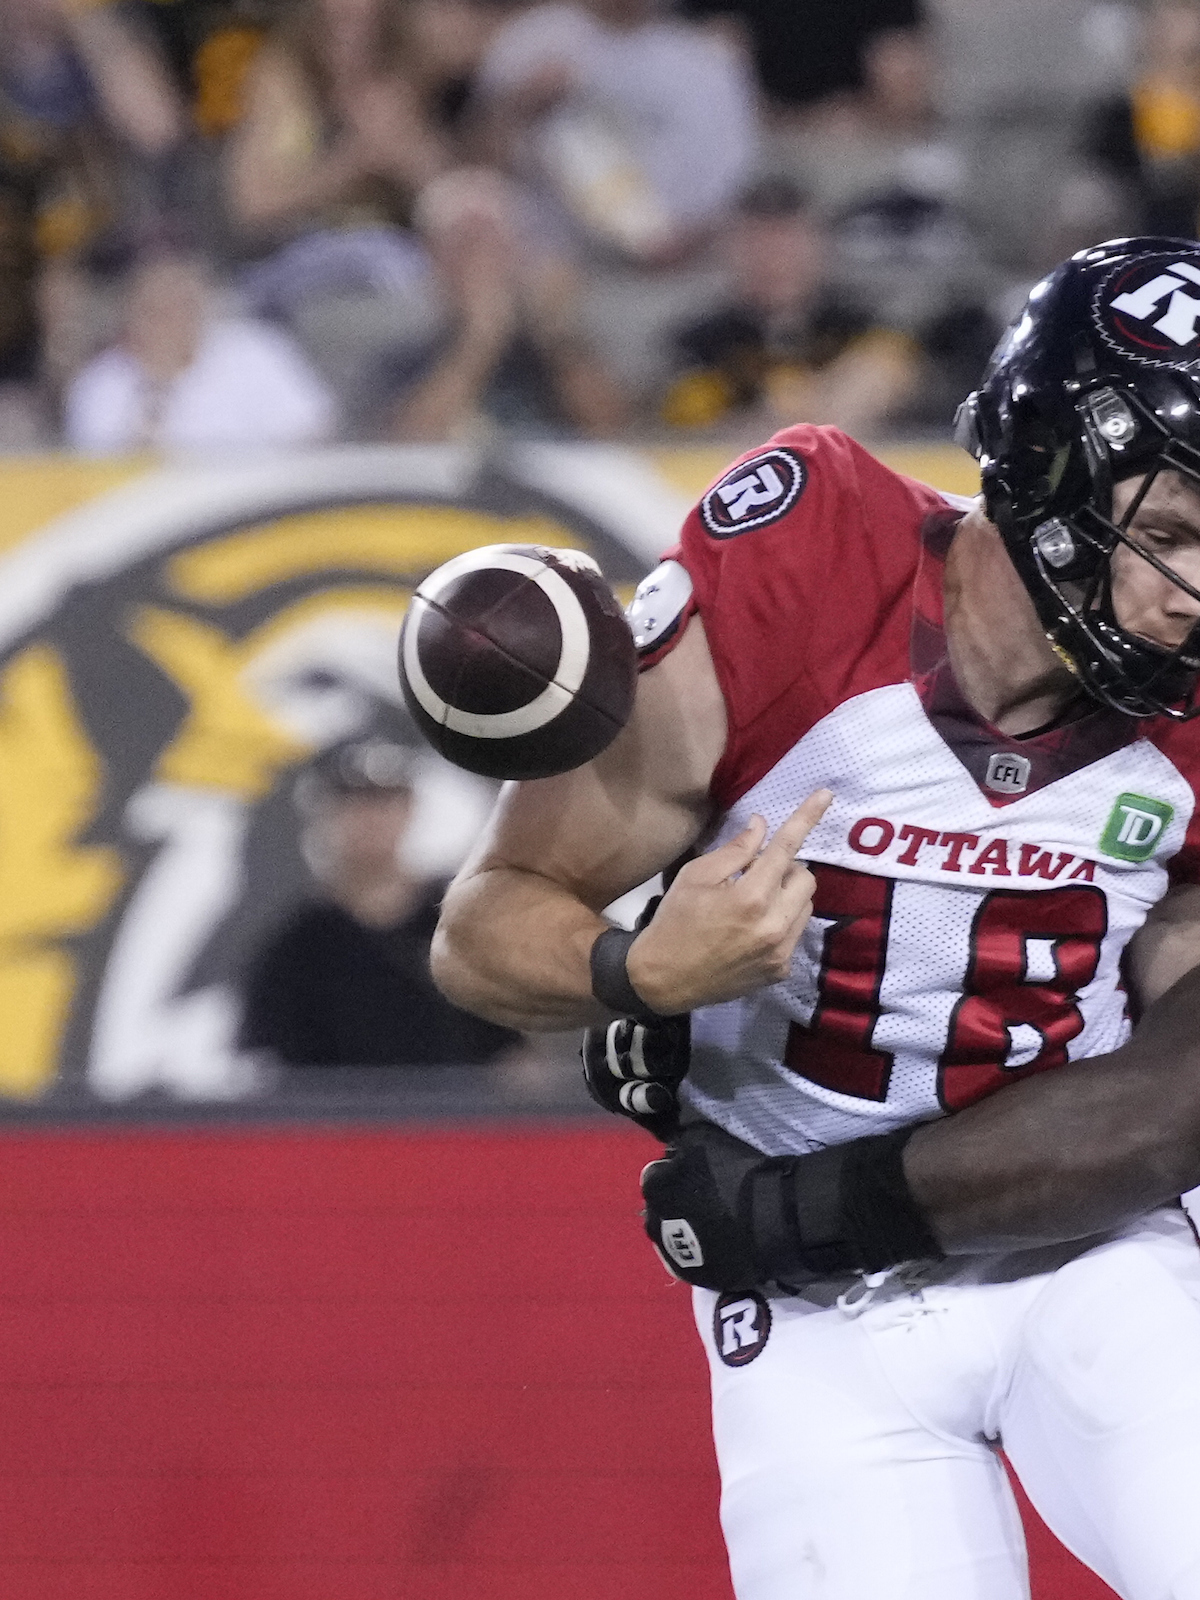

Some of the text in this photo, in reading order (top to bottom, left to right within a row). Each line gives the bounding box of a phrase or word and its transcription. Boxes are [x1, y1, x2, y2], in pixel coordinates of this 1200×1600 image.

[717, 464, 784, 521] R
[993, 765, 1021, 785] CFL
[848, 817, 1097, 882] OTTAWA
[1117, 805, 1162, 846] TD
[784, 862, 1107, 1113] 18
[720, 1298, 759, 1354] R
